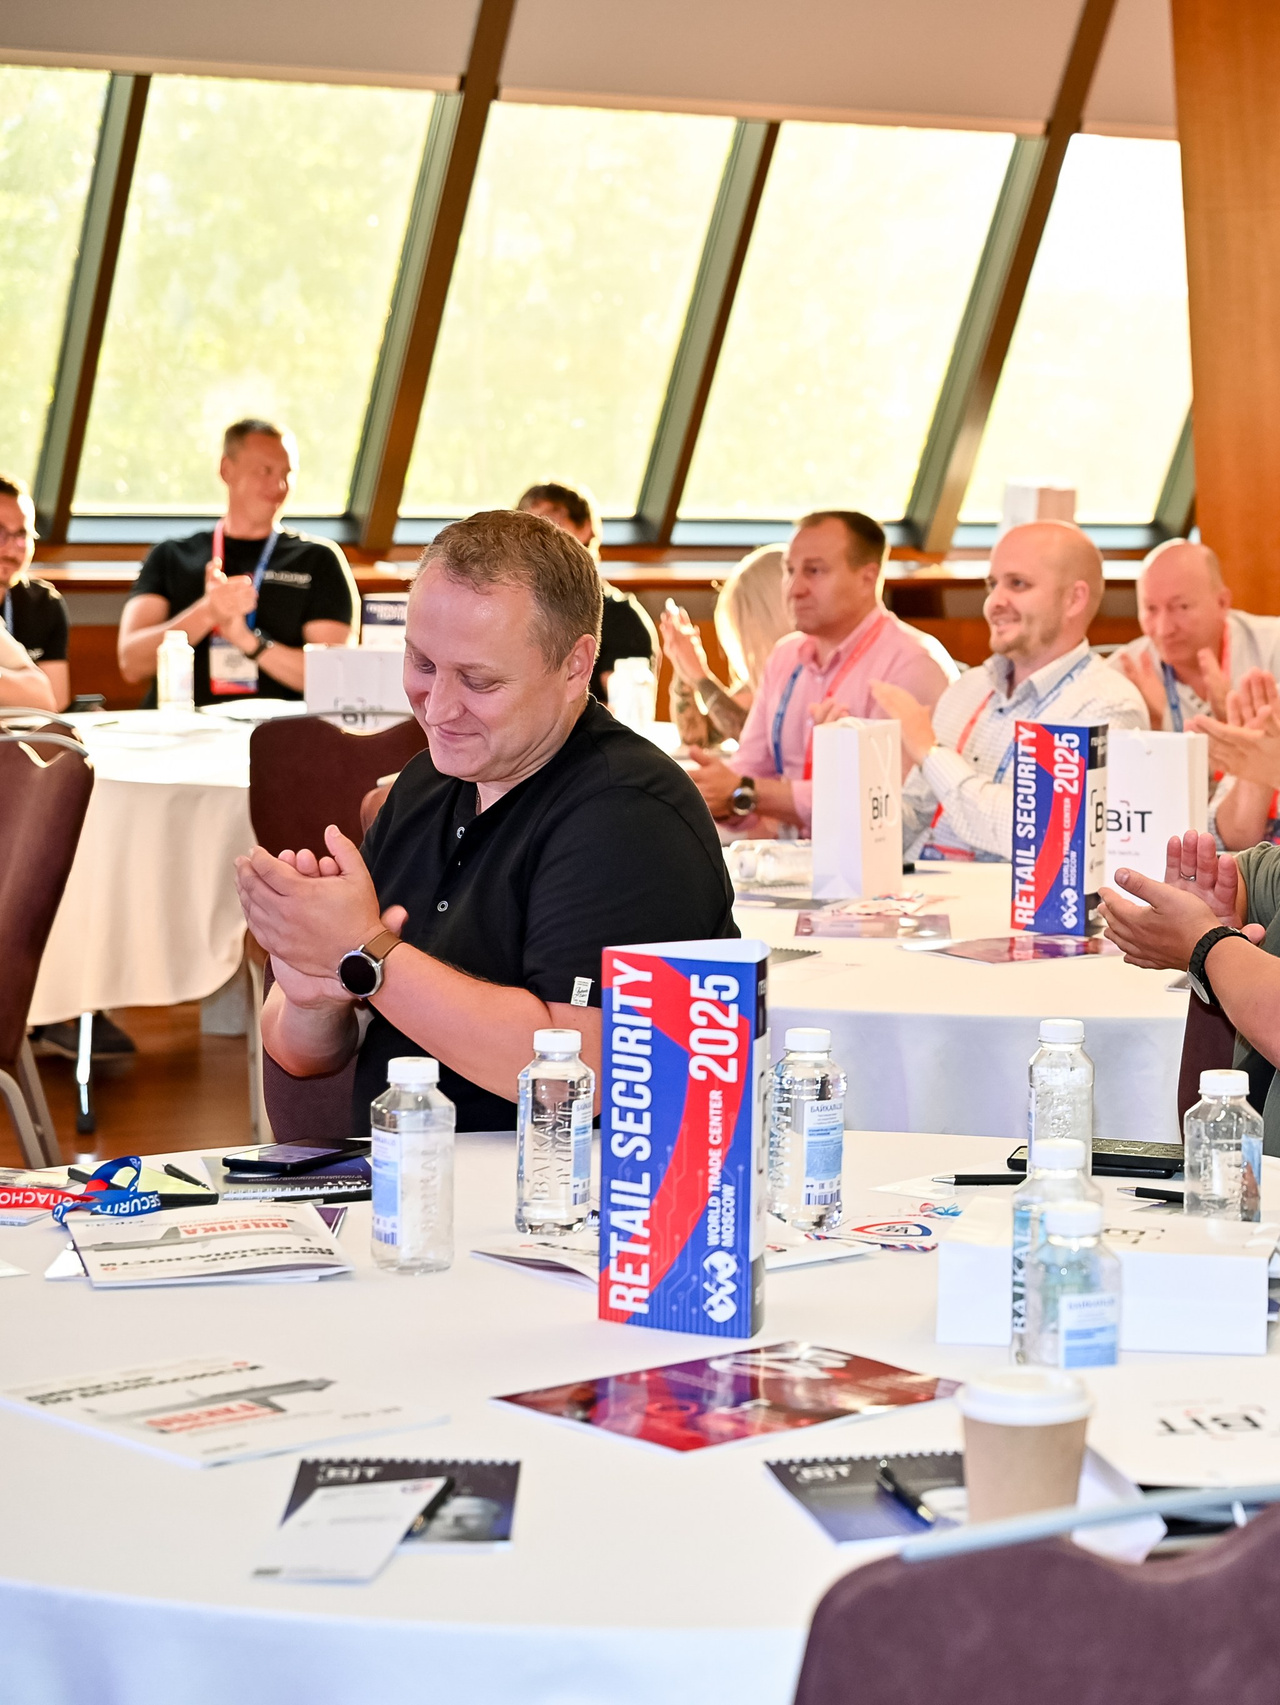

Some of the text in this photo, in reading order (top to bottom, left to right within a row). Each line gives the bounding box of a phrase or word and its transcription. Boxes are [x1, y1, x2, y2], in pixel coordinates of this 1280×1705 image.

[1053, 732, 1080, 794] 2025
[1014, 725, 1037, 925] RETAIL SECURITY
[1063, 797, 1071, 829] CENTER
[1069, 851, 1077, 886] MOSCOW
[688, 974, 740, 1083] 2025
[609, 958, 653, 1314] RETAIL SECURITY
[0, 1191, 81, 1206] ОПАСНО
[707, 1090, 723, 1247] WORLD TRADE CENTER
[92, 1194, 162, 1215] SECURITY
[182, 1220, 289, 1236] ОЦЕНКА
[721, 1184, 735, 1247] MOSCOW
[1012, 1228, 1031, 1334] BAIKAL
